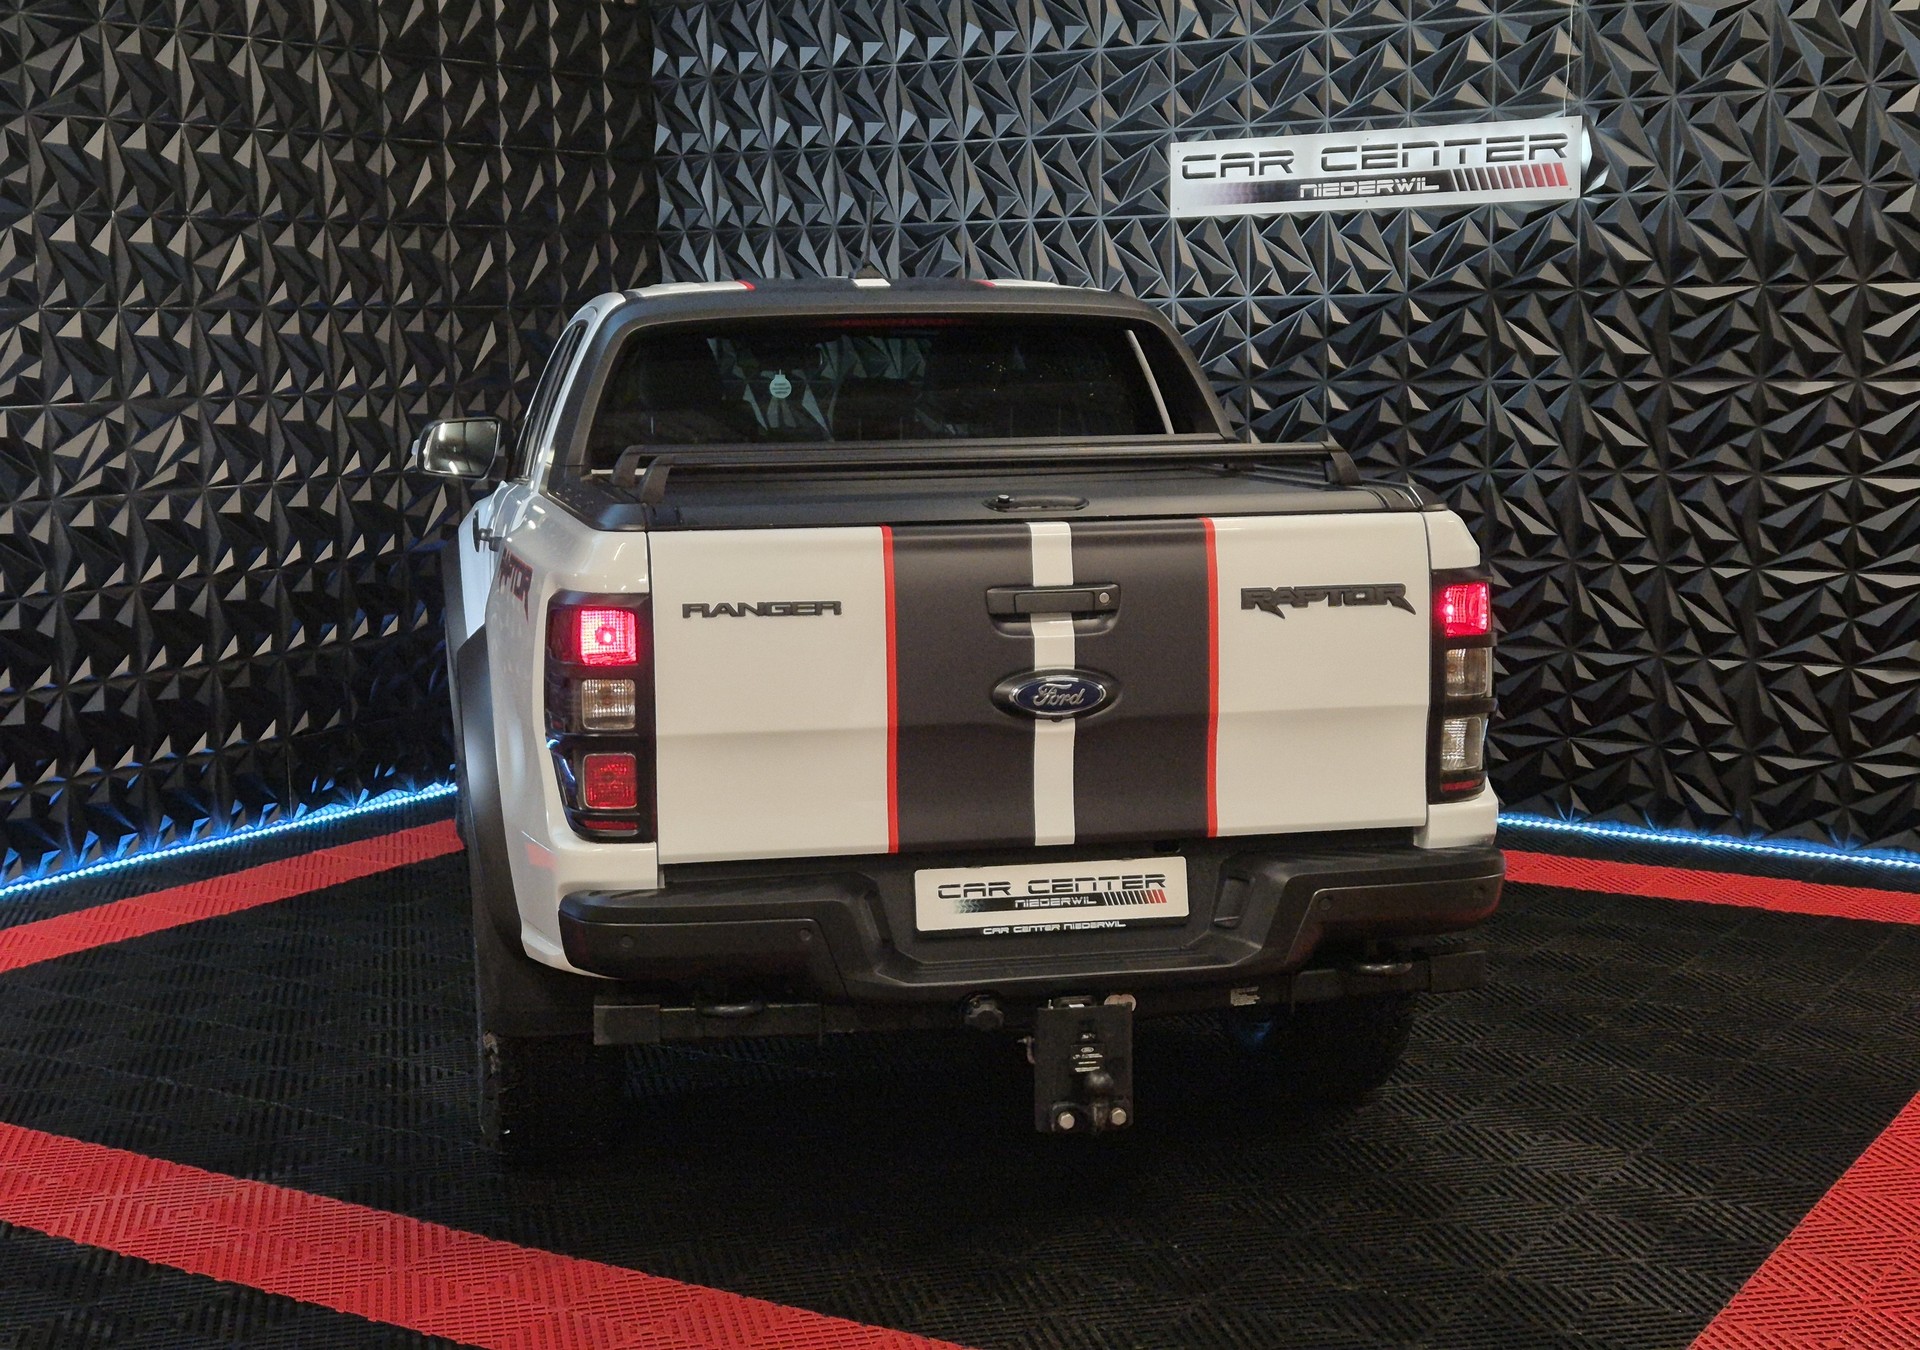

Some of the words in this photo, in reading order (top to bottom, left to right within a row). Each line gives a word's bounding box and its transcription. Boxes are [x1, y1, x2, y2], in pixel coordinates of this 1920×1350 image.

[1181, 149, 1294, 180] CAR
[1321, 132, 1569, 172] CENTER
[1300, 176, 1440, 198] NIEDERWIL
[682, 600, 842, 618] RANGER
[1240, 583, 1416, 619] RAPTOR
[1033, 683, 1085, 707] Ford
[938, 881, 1012, 899] CAR
[1028, 873, 1167, 894] CENTER
[1014, 896, 1097, 908] NIEDERWIL
[983, 927, 1009, 935] CAR
[1013, 923, 1061, 933] CENTER
[1063, 920, 1126, 931] NIEDERWIL
